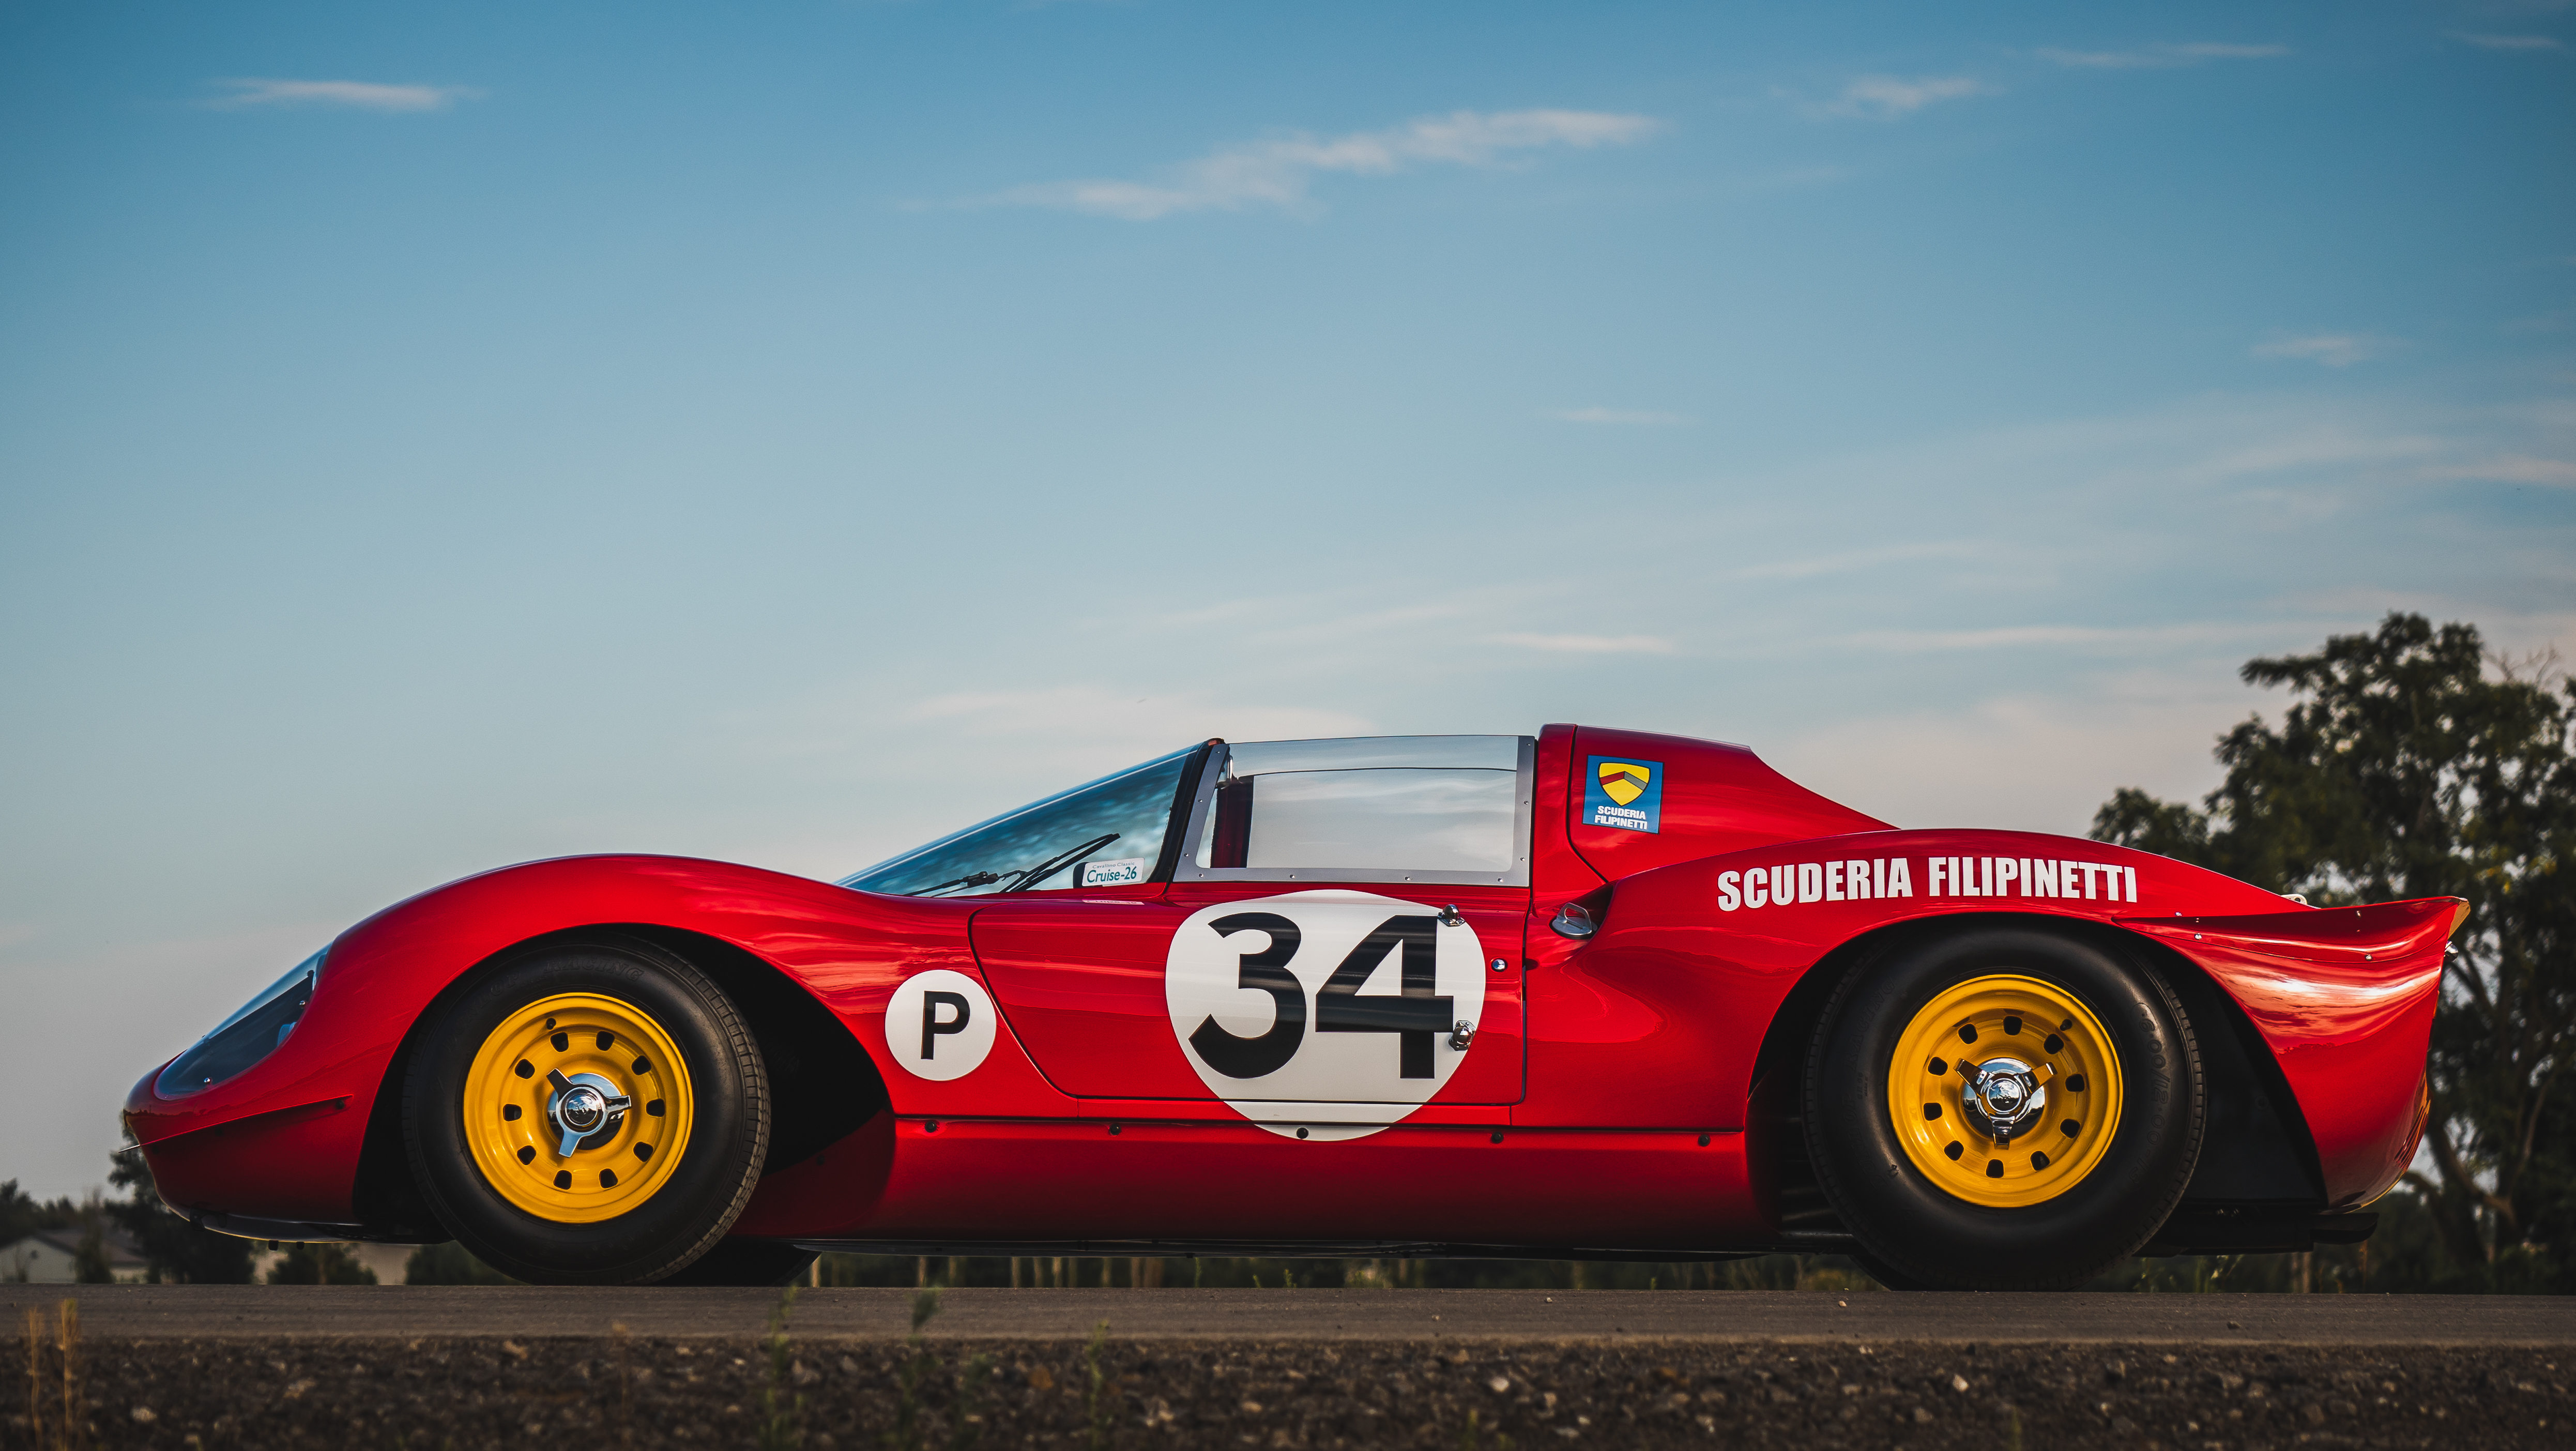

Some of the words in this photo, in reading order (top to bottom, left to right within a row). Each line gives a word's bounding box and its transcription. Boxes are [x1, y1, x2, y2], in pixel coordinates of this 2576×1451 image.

[1595, 815, 1648, 830] FILIPINETTI
[1598, 806, 1646, 820] SCUDERIA
[1087, 866, 1137, 882] Cruise-26
[1718, 858, 1913, 911] SCUDERIA
[1929, 857, 2138, 903] FILIPINETTI
[443, 971, 520, 1049] DUNLOP
[546, 958, 643, 982] RACING
[921, 991, 970, 1060] P
[1188, 912, 1454, 1079] 34
[1843, 977, 1896, 1071] RACING
